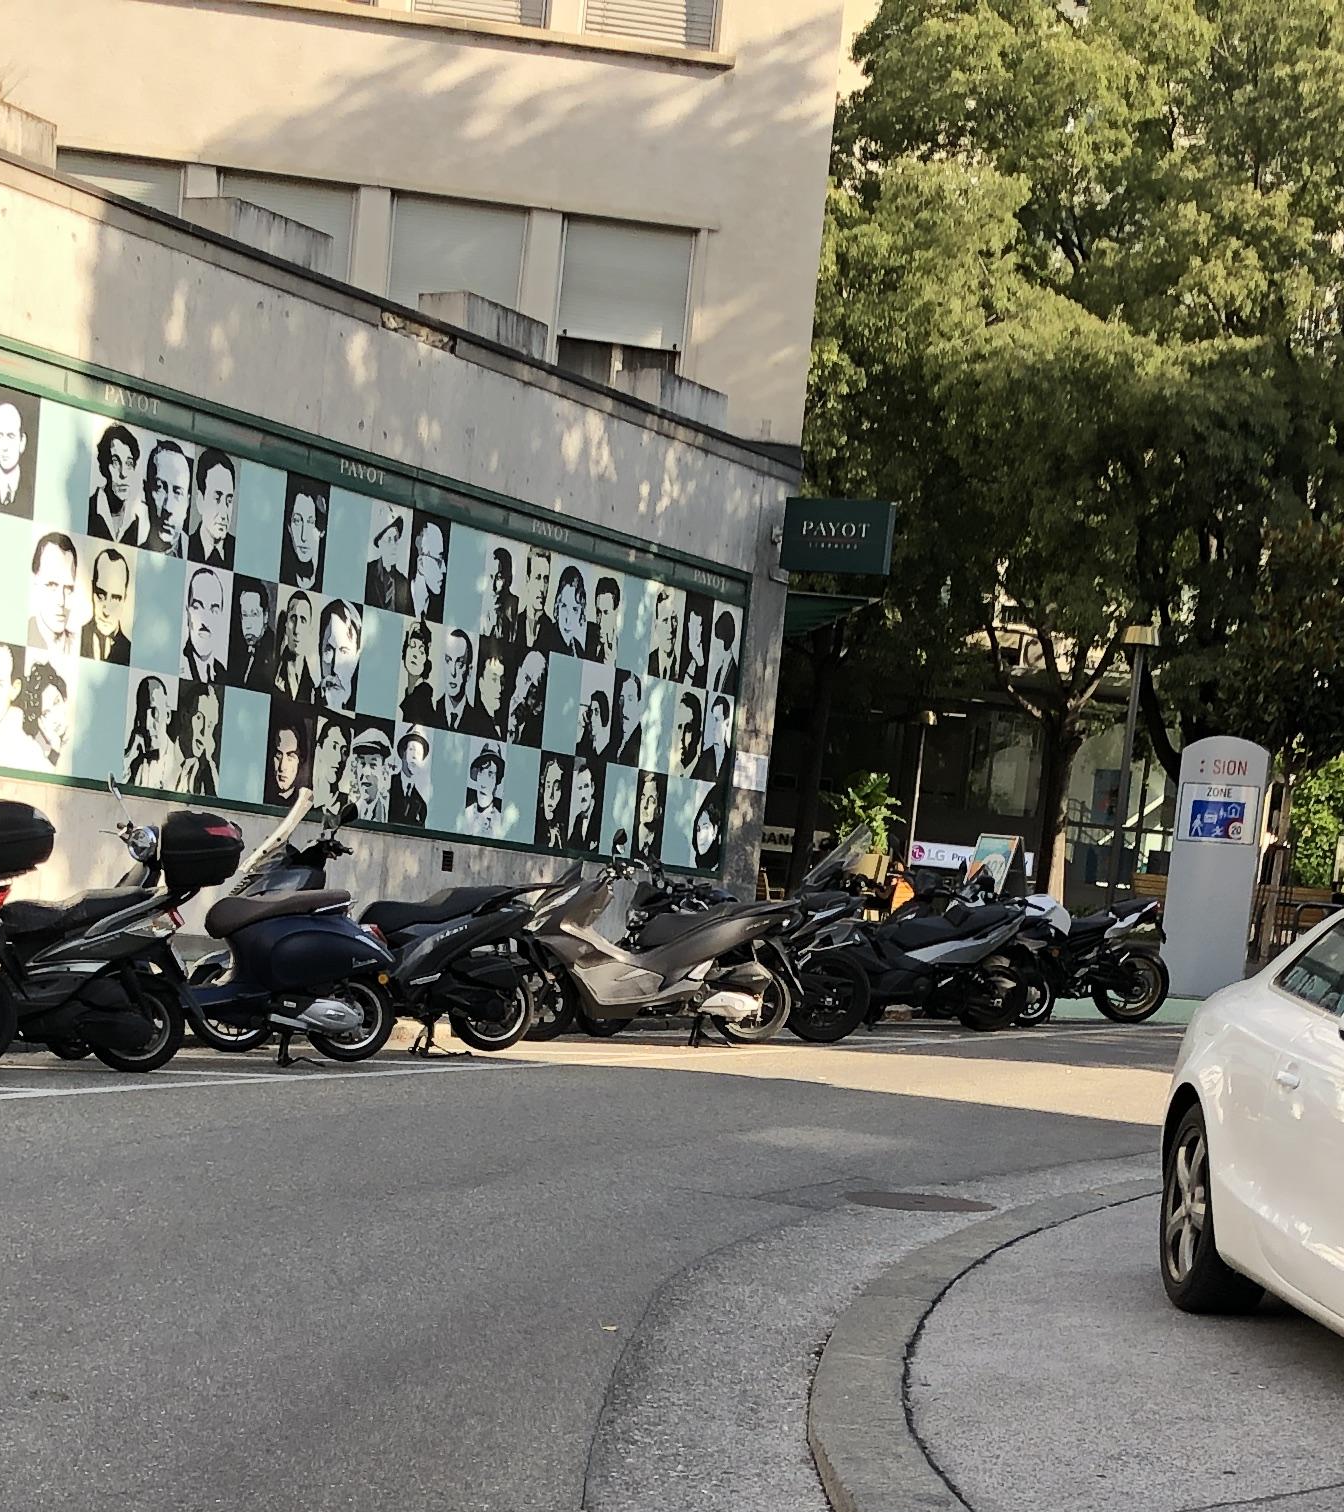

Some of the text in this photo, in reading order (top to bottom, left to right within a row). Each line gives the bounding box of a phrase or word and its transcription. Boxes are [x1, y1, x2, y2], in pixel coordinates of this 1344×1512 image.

[105, 384, 161, 415] PAYOT
[340, 458, 386, 486] PAYOT
[532, 519, 569, 543] PAYOT
[802, 520, 870, 538] PAYOT
[694, 569, 725, 593] PAYOT
[1212, 759, 1248, 776] SION
[1206, 787, 1233, 798] ZONE
[1230, 826, 1242, 836] 20
[927, 849, 946, 861] LG
